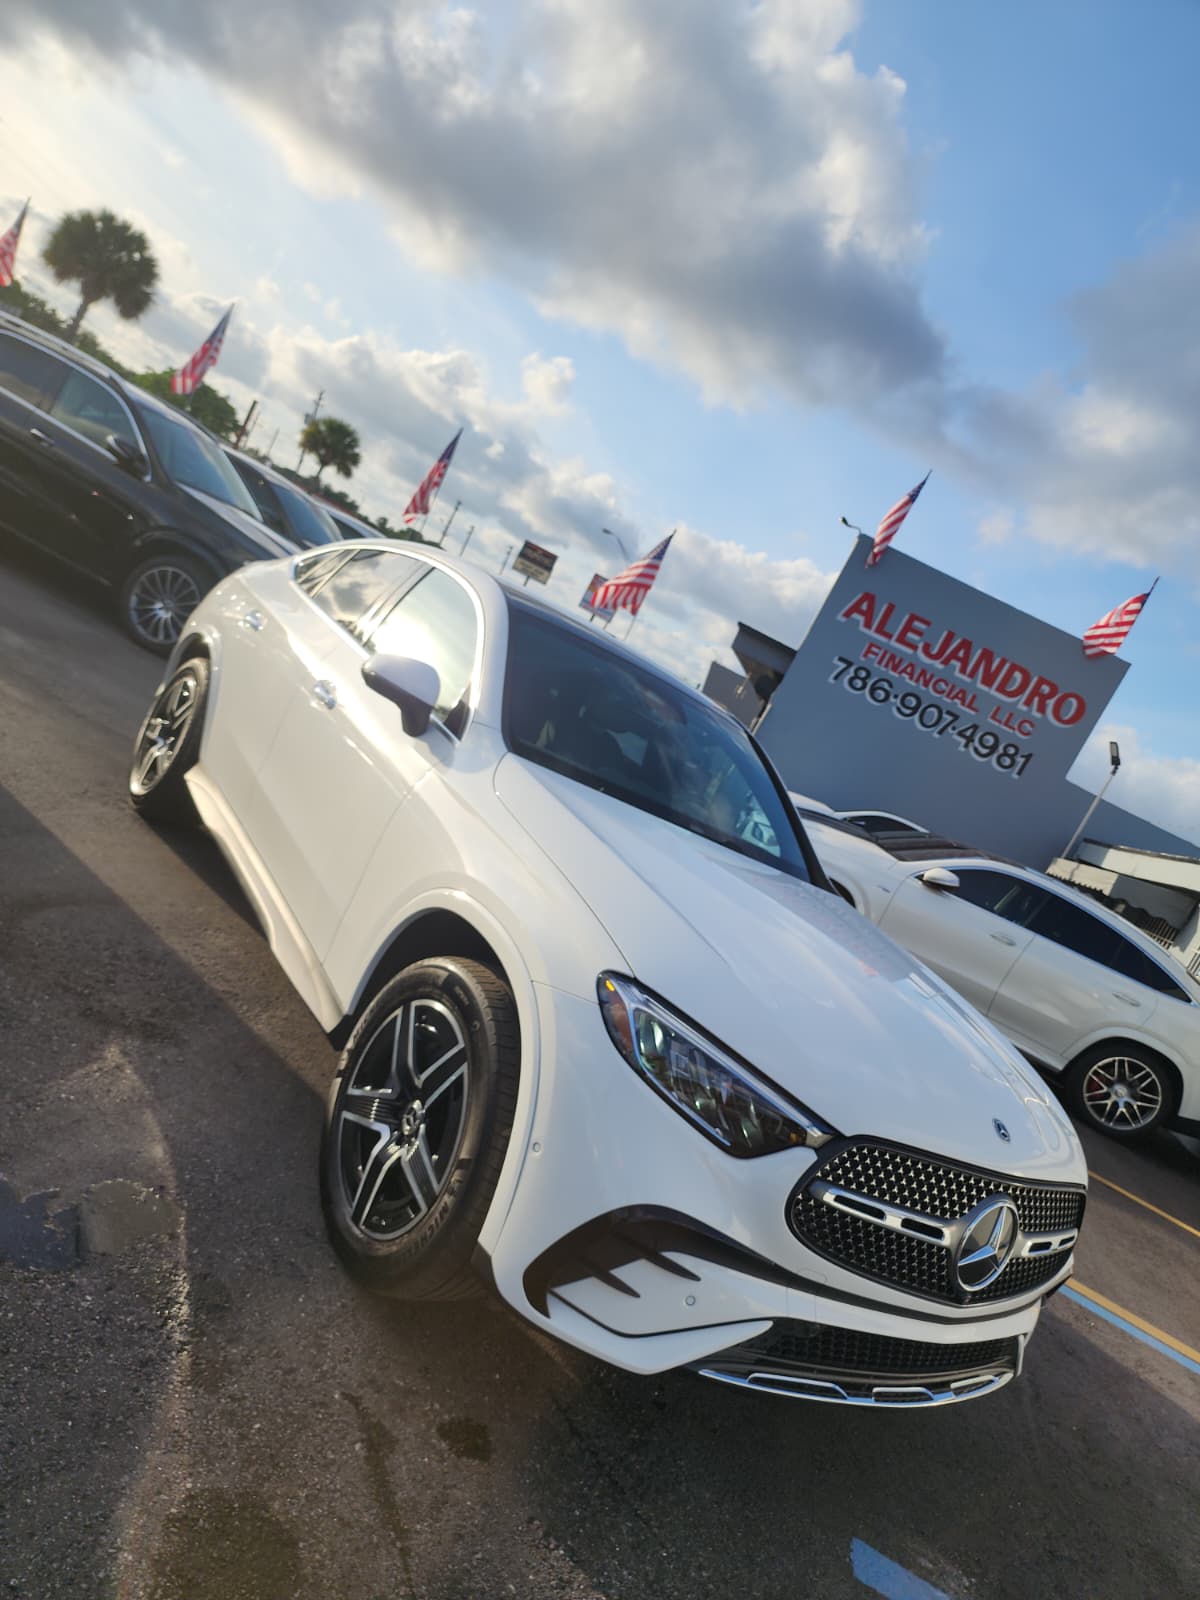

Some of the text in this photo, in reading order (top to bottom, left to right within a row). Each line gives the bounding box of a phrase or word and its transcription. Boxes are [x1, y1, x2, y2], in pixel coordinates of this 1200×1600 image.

[839, 591, 1087, 727] ALEJANDRO
[861, 642, 1036, 738] FINANCIAL LLC
